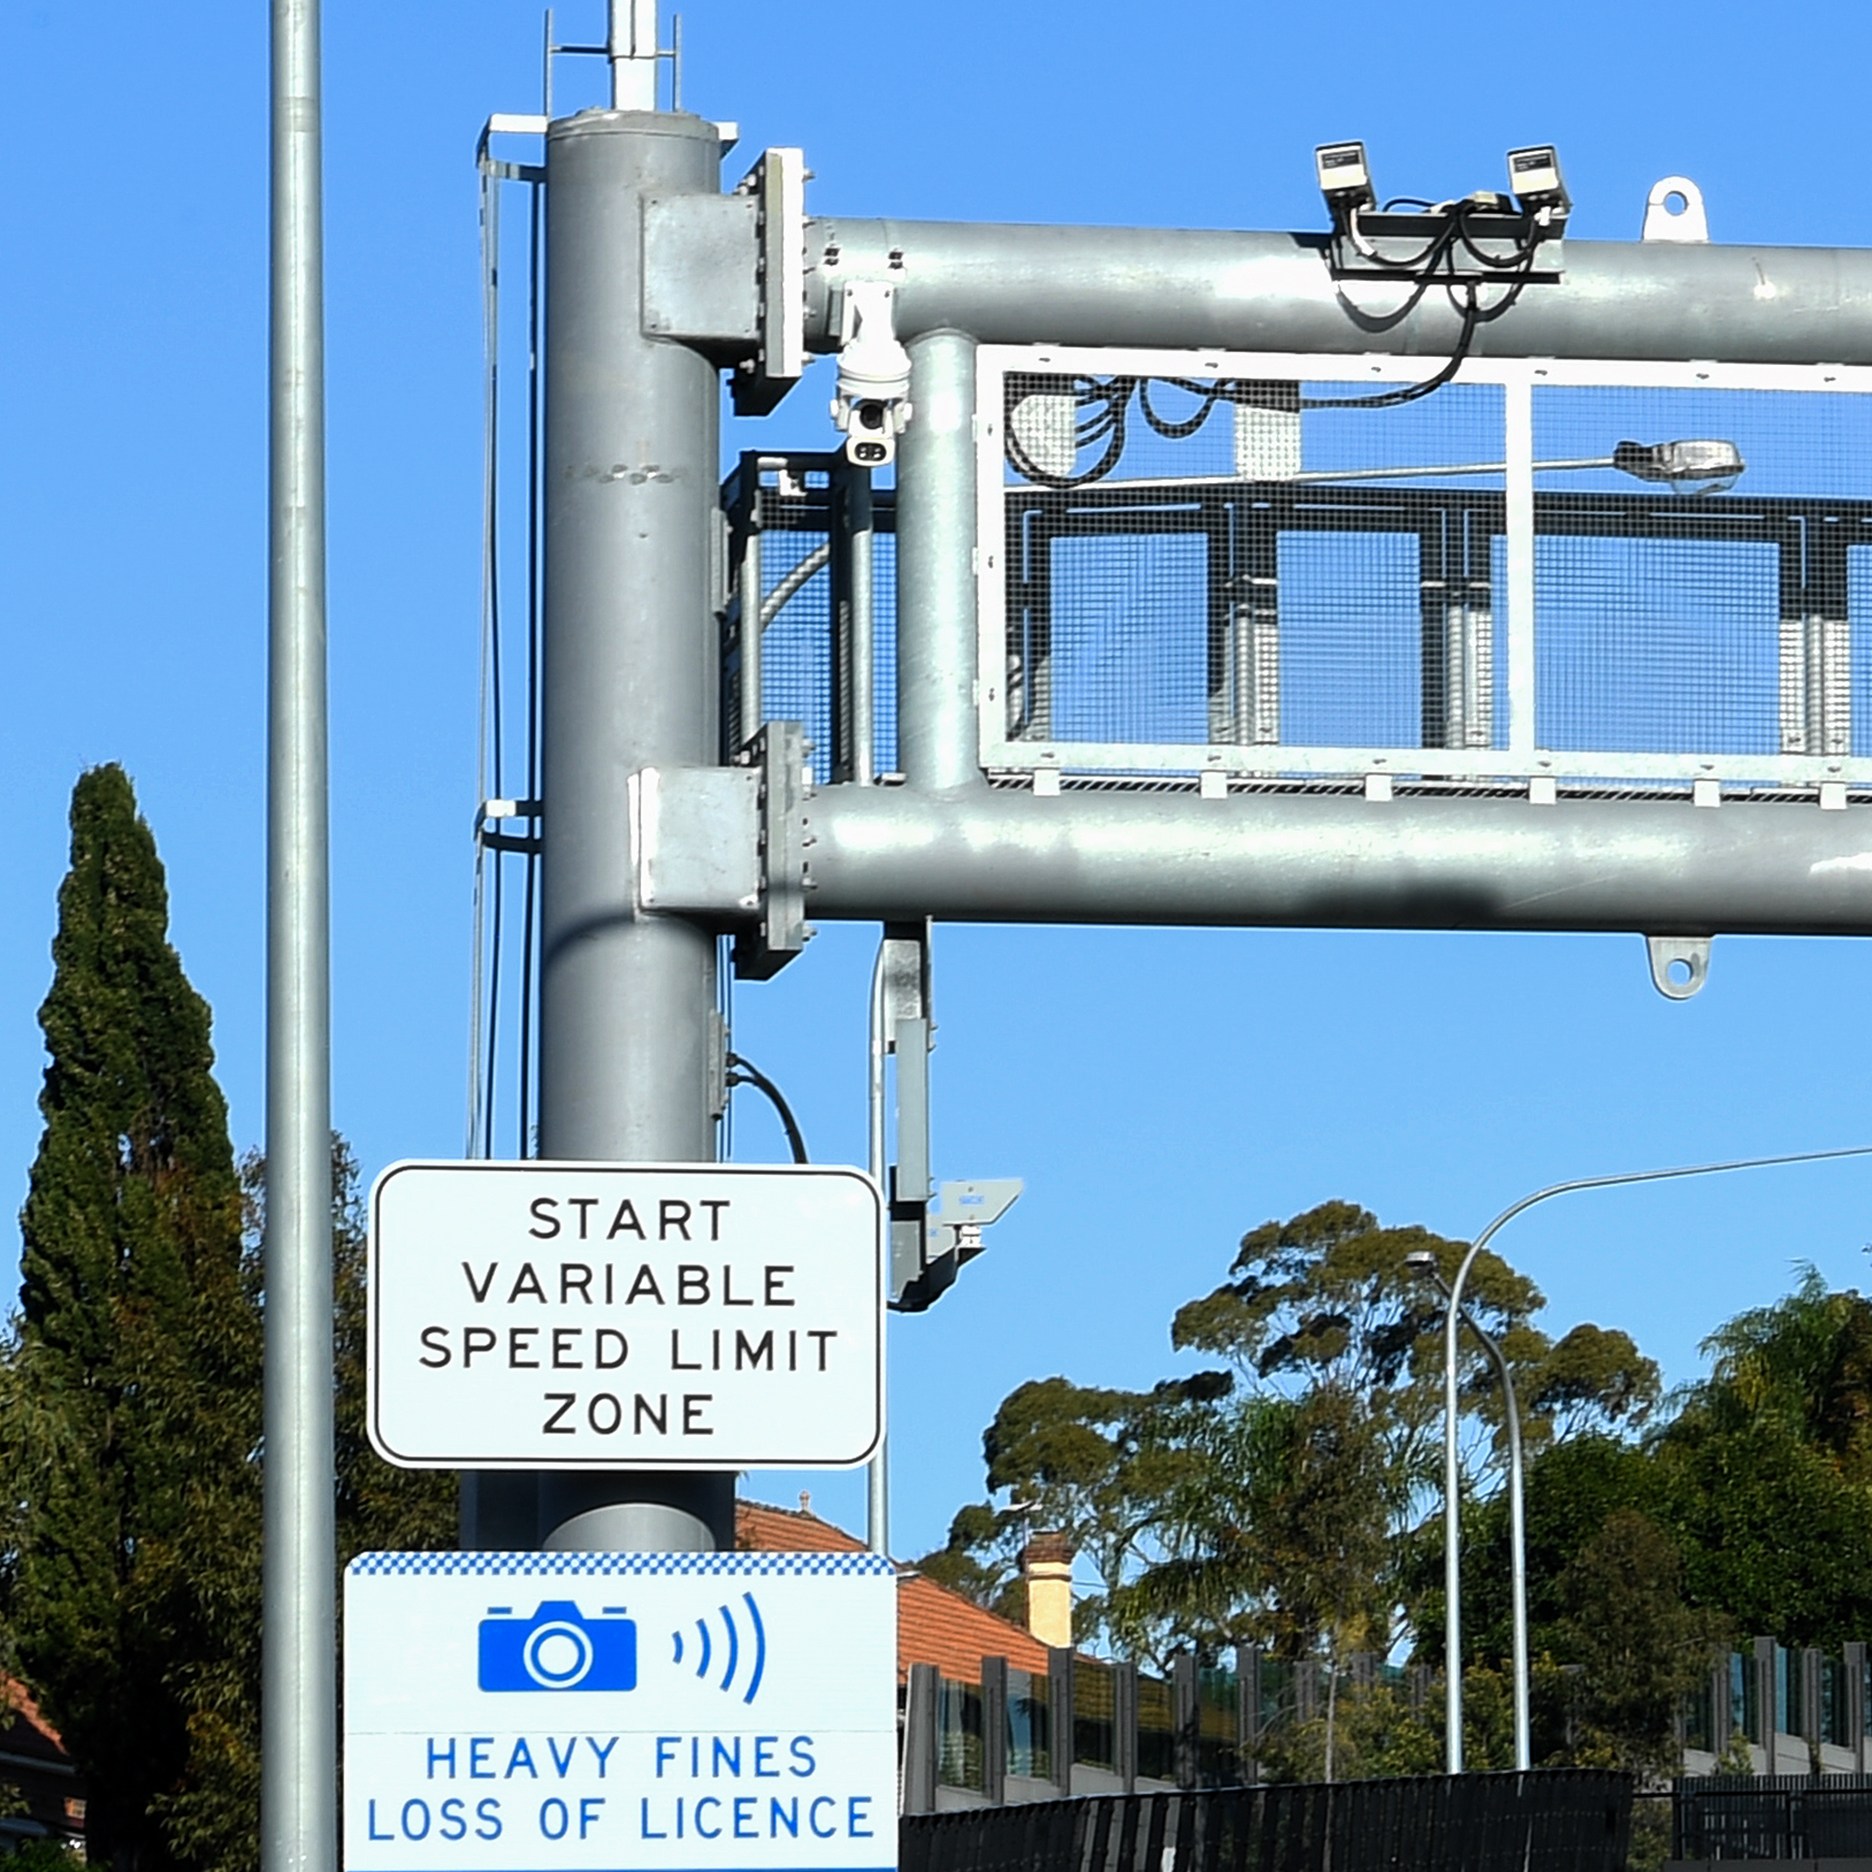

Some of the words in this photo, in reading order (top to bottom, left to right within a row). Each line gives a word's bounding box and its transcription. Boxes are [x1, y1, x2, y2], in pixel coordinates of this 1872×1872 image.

[529, 1197, 730, 1241] START
[462, 1261, 795, 1306] VARIABLE
[419, 1326, 628, 1369] SPEED
[671, 1329, 837, 1372] LIMIT
[543, 1393, 713, 1435] ZONE
[427, 1736, 619, 1779] HEAVY
[656, 1735, 816, 1778] FINES
[368, 1797, 503, 1841] LOSS
[539, 1797, 606, 1840] OF
[641, 1795, 874, 1839] LICENCE
